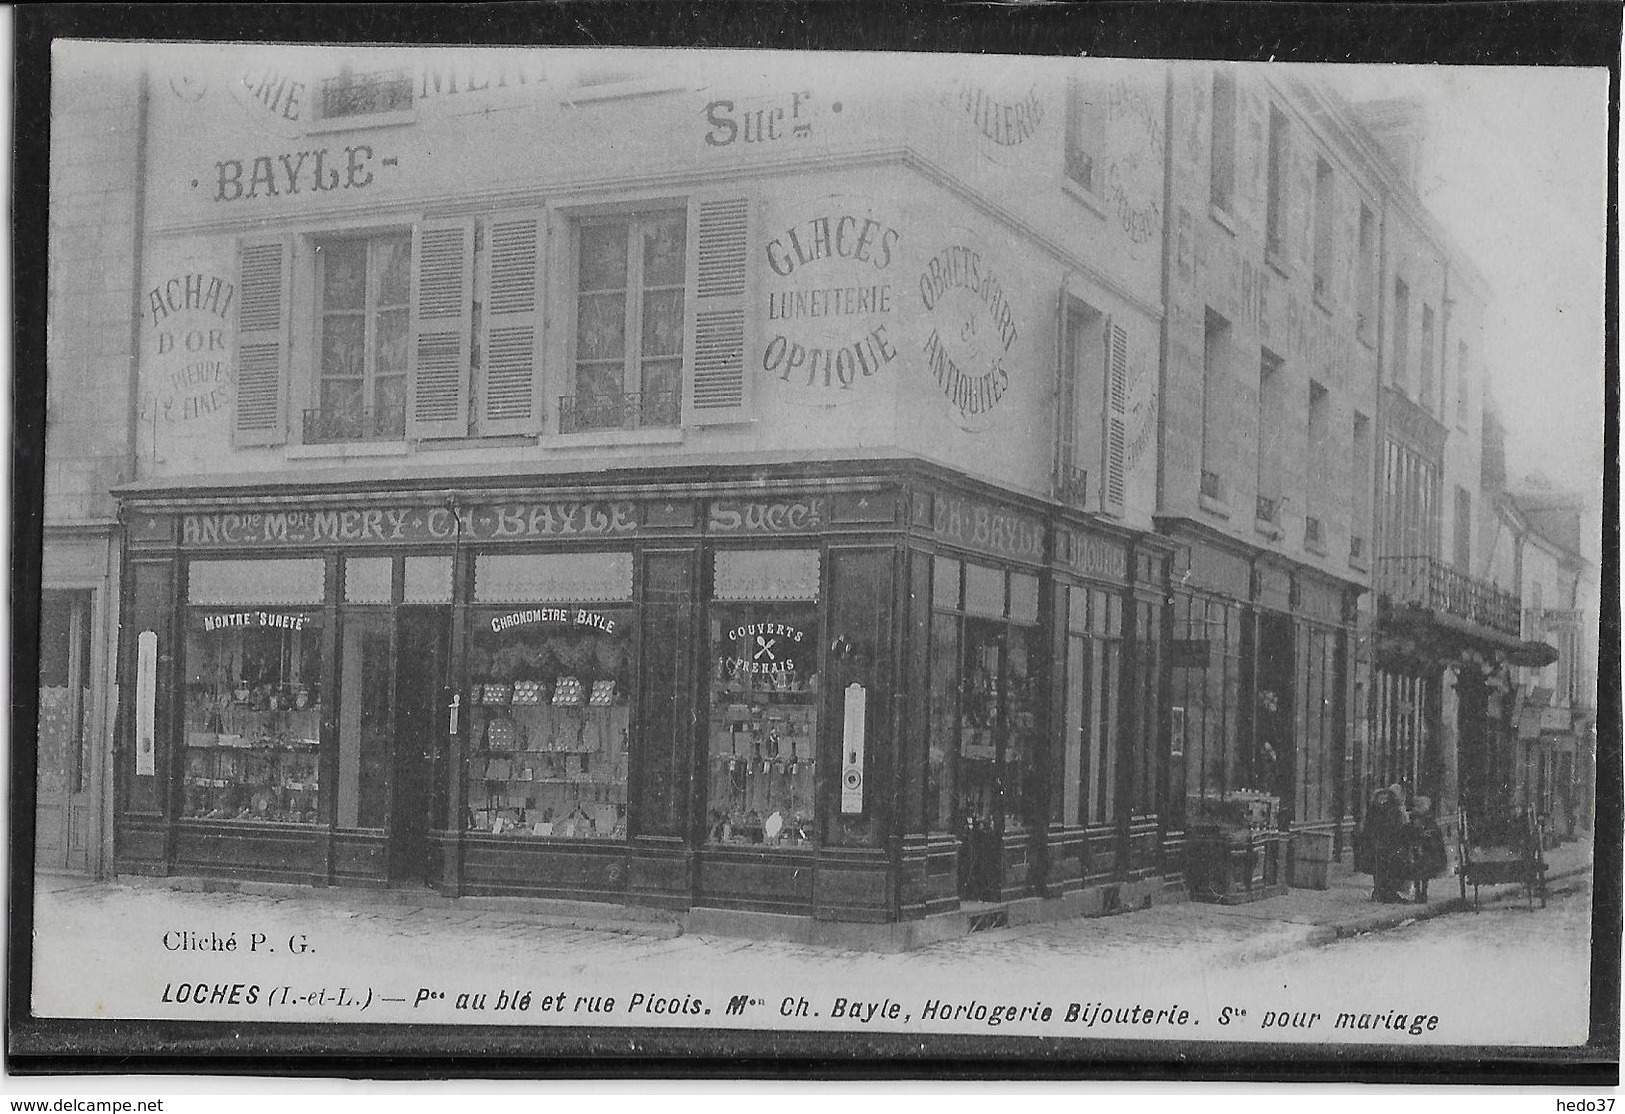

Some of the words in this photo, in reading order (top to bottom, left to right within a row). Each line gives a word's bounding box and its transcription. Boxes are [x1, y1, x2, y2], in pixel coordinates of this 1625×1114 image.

[920, 245, 981, 312] OBJETS
[768, 285, 891, 320] LUNETTERIE
[762, 324, 898, 389] OPTIQUE
[312, 507, 413, 541] MERY
[491, 500, 638, 538] BAYLE
[970, 506, 1046, 560] BAYLE
[204, 613, 250, 632] MONTRE
[577, 608, 616, 635] BAYLE
[728, 623, 804, 642] COUVERTS
